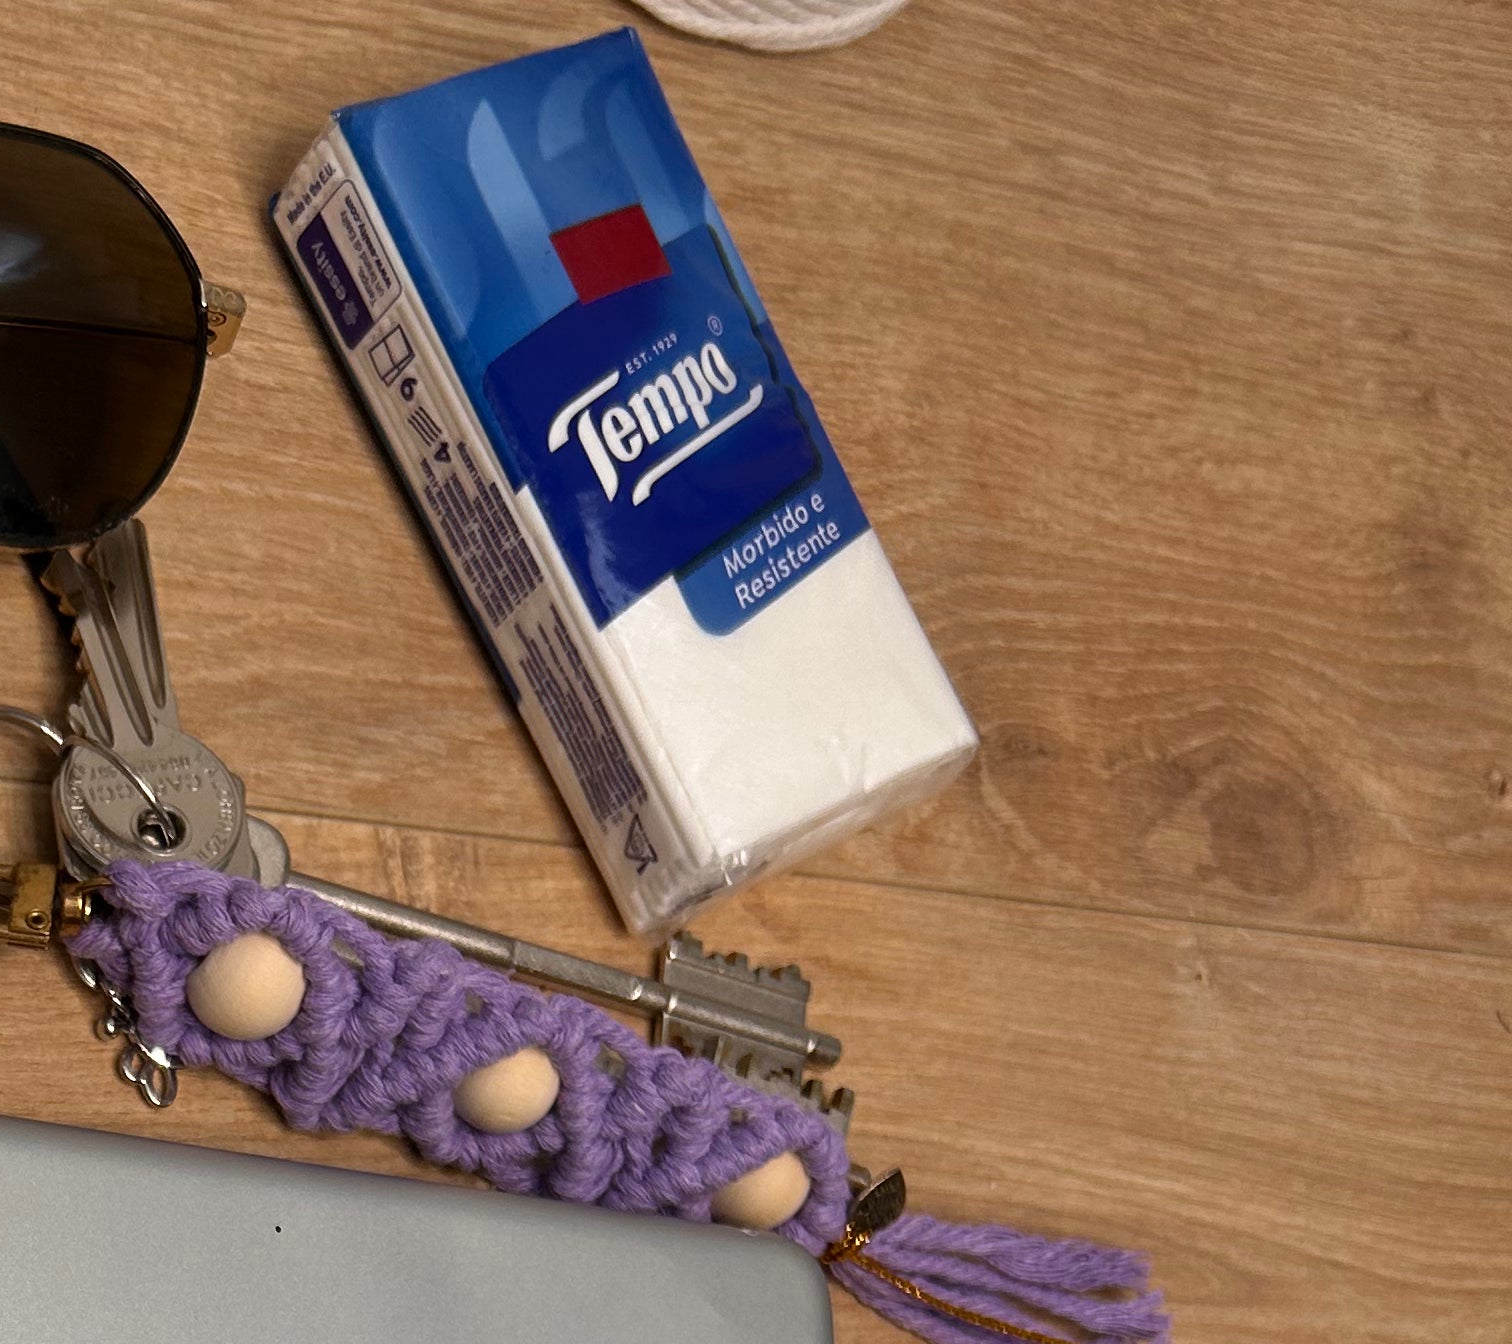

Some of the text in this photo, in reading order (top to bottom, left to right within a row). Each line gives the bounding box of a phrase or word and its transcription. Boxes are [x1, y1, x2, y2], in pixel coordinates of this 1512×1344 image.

[311, 241, 347, 301] essity
[624, 331, 679, 375] EST. 1929
[548, 342, 738, 503] Tempo
[722, 492, 826, 579] Morbido e
[734, 520, 841, 610] Resistente
